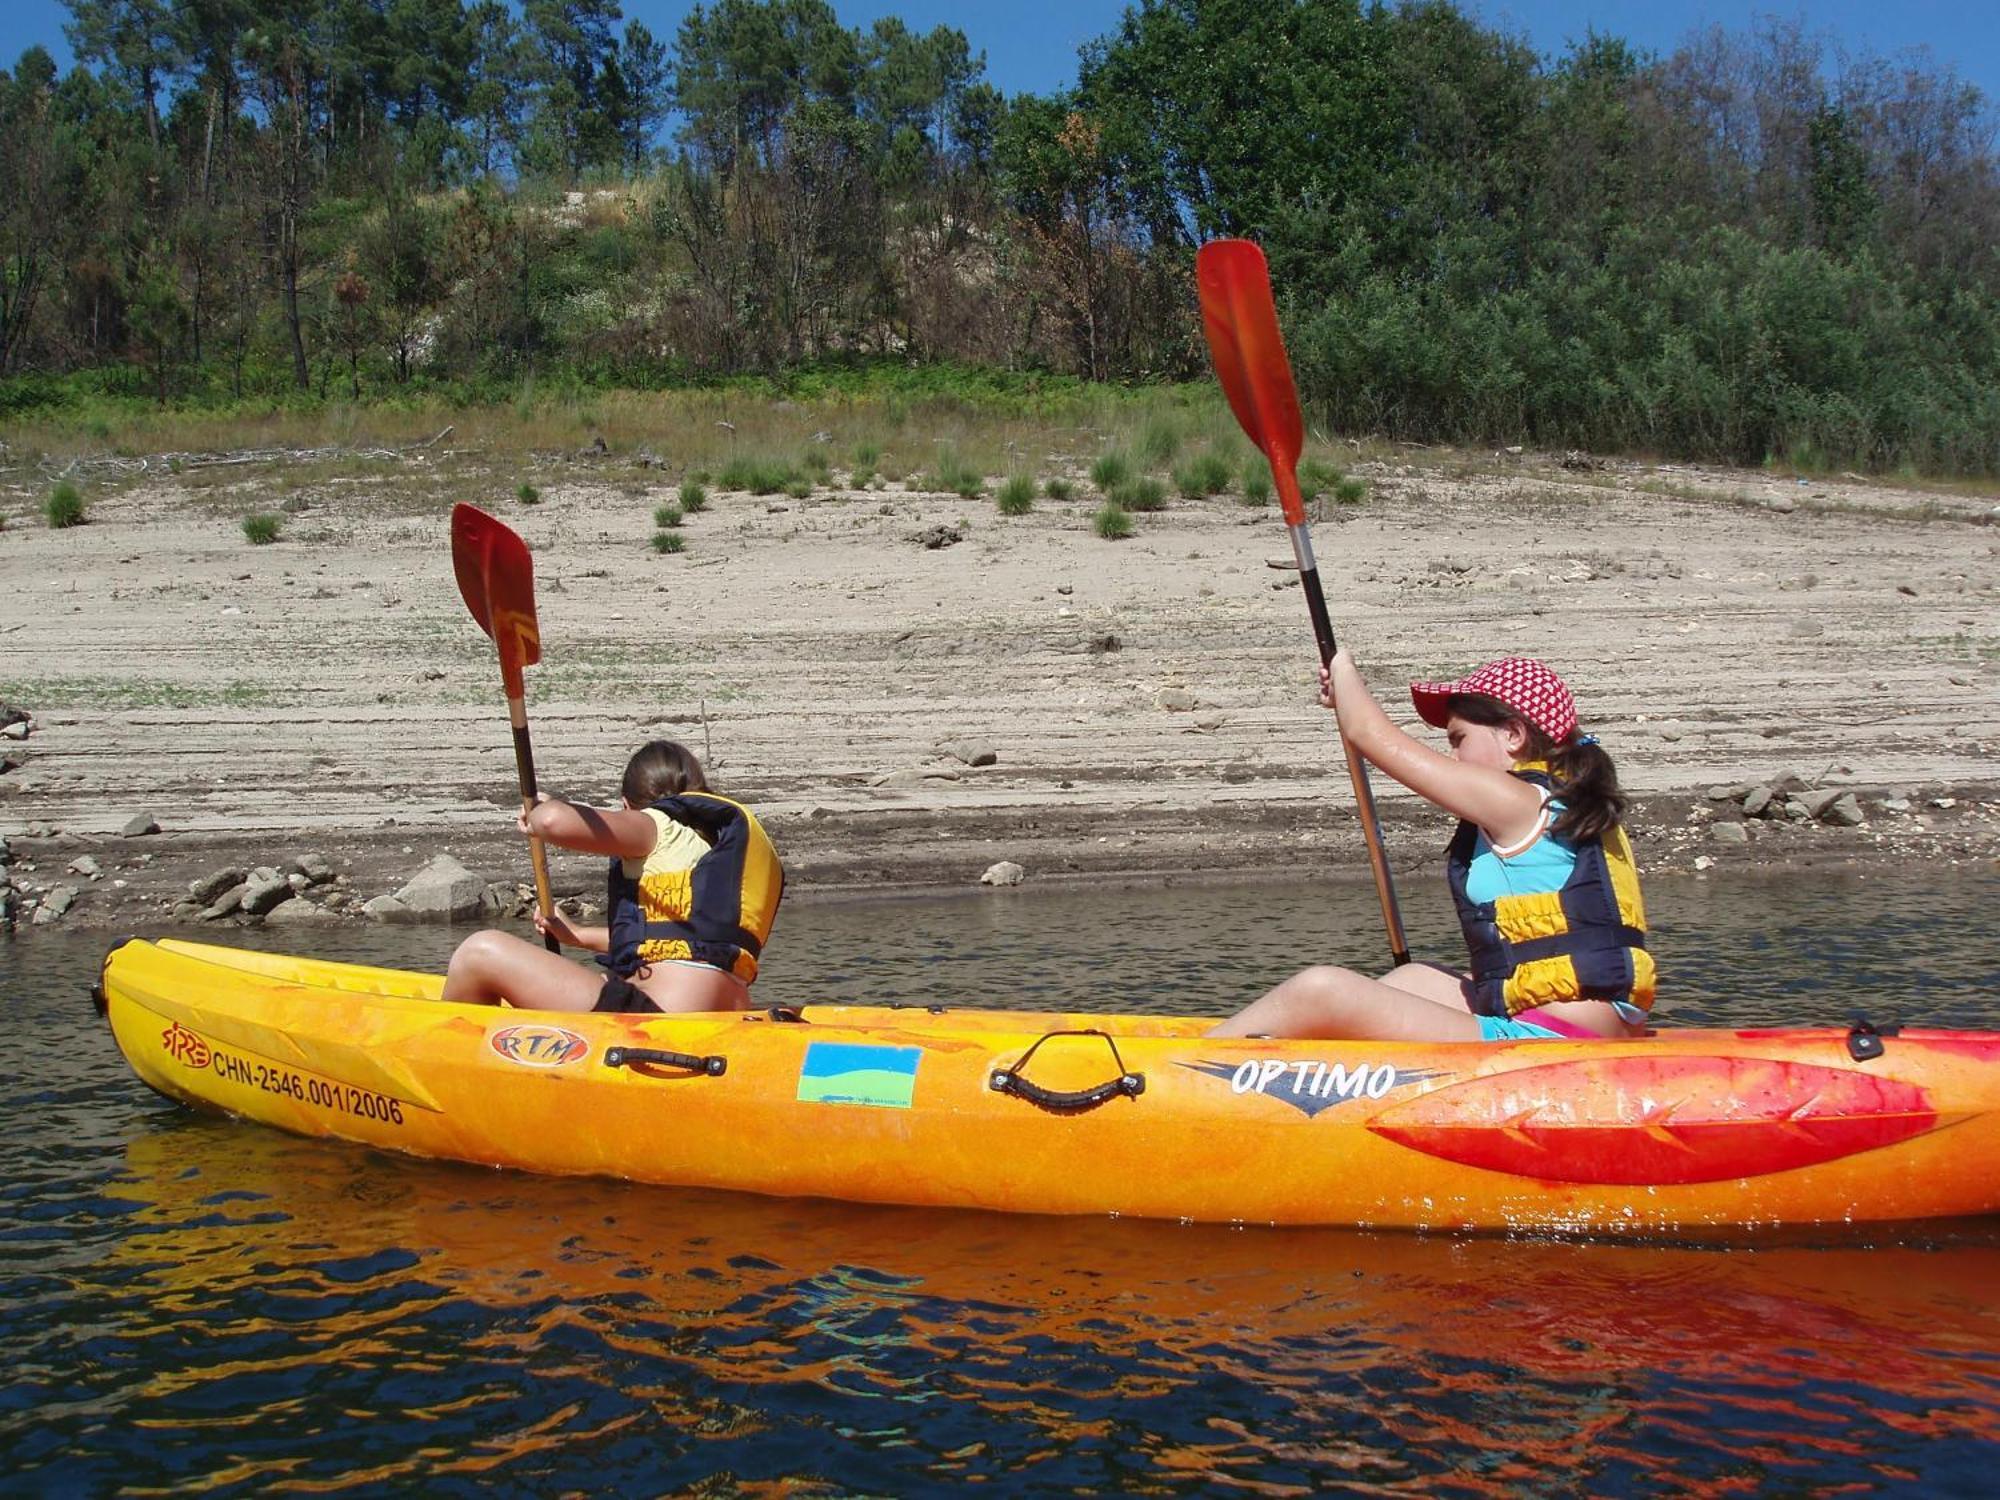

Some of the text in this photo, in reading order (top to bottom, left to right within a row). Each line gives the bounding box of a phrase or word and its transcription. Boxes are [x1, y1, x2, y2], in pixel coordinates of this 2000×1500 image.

[499, 1034, 579, 1062] RTM
[213, 1052, 404, 1125] CHN-2546.001/2006
[1231, 1058, 1397, 1100] OPTIMO
